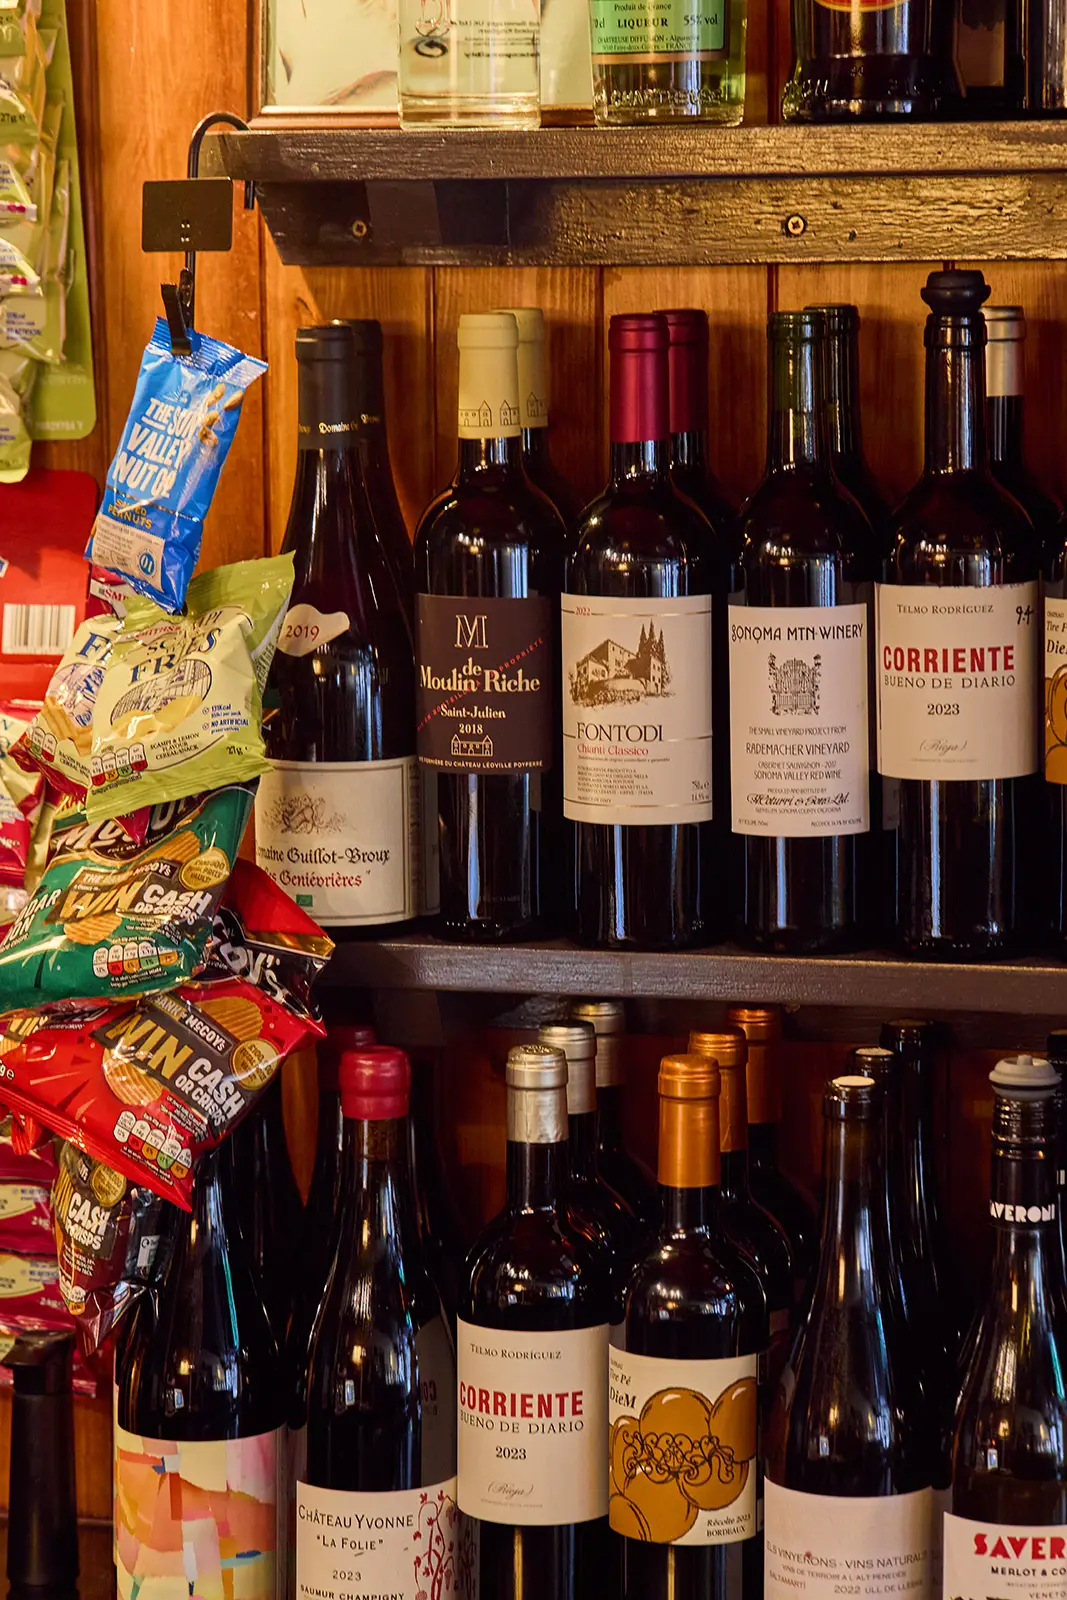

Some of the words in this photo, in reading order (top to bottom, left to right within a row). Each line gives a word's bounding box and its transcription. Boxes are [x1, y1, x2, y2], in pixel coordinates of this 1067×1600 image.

[617, 18, 668, 29] LIQUEUR
[704, 13, 718, 25] vol
[146, 397, 174, 422] THE
[127, 422, 193, 471] VALLEY
[111, 451, 158, 492] NUT
[108, 503, 152, 529] PEANUTS
[897, 604, 928, 614] TELMO
[932, 604, 994, 614] RODRÍGUEZ
[285, 624, 320, 642] 2019
[454, 614, 489, 649] M
[732, 624, 781, 644] SONOMA
[818, 624, 864, 640] WINERY
[462, 656, 482, 676] de
[883, 645, 1014, 674] CORRIENTE
[420, 664, 478, 692] Moulin
[483, 668, 540, 692] Riche
[884, 674, 926, 688] BUENO
[932, 677, 952, 688] DE
[961, 674, 1016, 688] DIARIO
[440, 704, 506, 718] Saint-Julien
[927, 702, 960, 716] 2023
[212, 720, 218, 728] NO
[220, 718, 249, 728] ARTIFICIAL
[459, 722, 484, 734] 2018
[576, 721, 662, 742] FONTODI
[150, 738, 170, 750] SCAMPI
[178, 732, 200, 742] LEMON
[577, 743, 605, 754] Chianti
[607, 744, 649, 756] Classico
[746, 742, 804, 756] RADEMACHER
[804, 741, 850, 756] VINEYARD
[155, 750, 176, 762] CEREAL
[176, 744, 199, 755] SNACK
[754, 770, 782, 780] SONOMA
[783, 770, 809, 780] VALLEY
[810, 770, 824, 780] RED
[824, 769, 842, 780] WINE
[59, 880, 147, 920] WIN
[134, 902, 154, 914] OR
[143, 884, 213, 916] CASH
[104, 1013, 194, 1080] WIN
[174, 1074, 194, 1095] OR
[187, 1057, 246, 1120] CASH
[68, 1191, 112, 1236] CASH
[470, 1343, 498, 1358] TELMO
[501, 1348, 562, 1360] RODRÍGUEZ
[460, 1380, 584, 1419] CORRIENTE
[609, 1385, 636, 1410] DieM
[460, 1408, 494, 1430] BUENO
[500, 1421, 520, 1434] DE
[528, 1420, 584, 1435] DIARIO
[496, 1446, 527, 1460] 2023
[298, 1503, 351, 1528] CHÂTEAU
[354, 1512, 413, 1530] YVONNE
[706, 1516, 736, 1528] Récolte
[706, 1525, 748, 1538] BORDEAUX
[974, 1532, 1066, 1560] SAVER
[777, 1547, 837, 1568] VINYERONS
[844, 1558, 874, 1569] VINS
[332, 1568, 362, 1581] 2023
[796, 1568, 804, 1576] DE
[807, 1569, 840, 1581] TERROIR
[991, 1566, 1037, 1577] MERLOT
[1040, 1568, 1048, 1578] &
[300, 1582, 335, 1600] SAUMUR
[864, 1586, 882, 1594] ULL
[884, 1584, 896, 1594] DE
